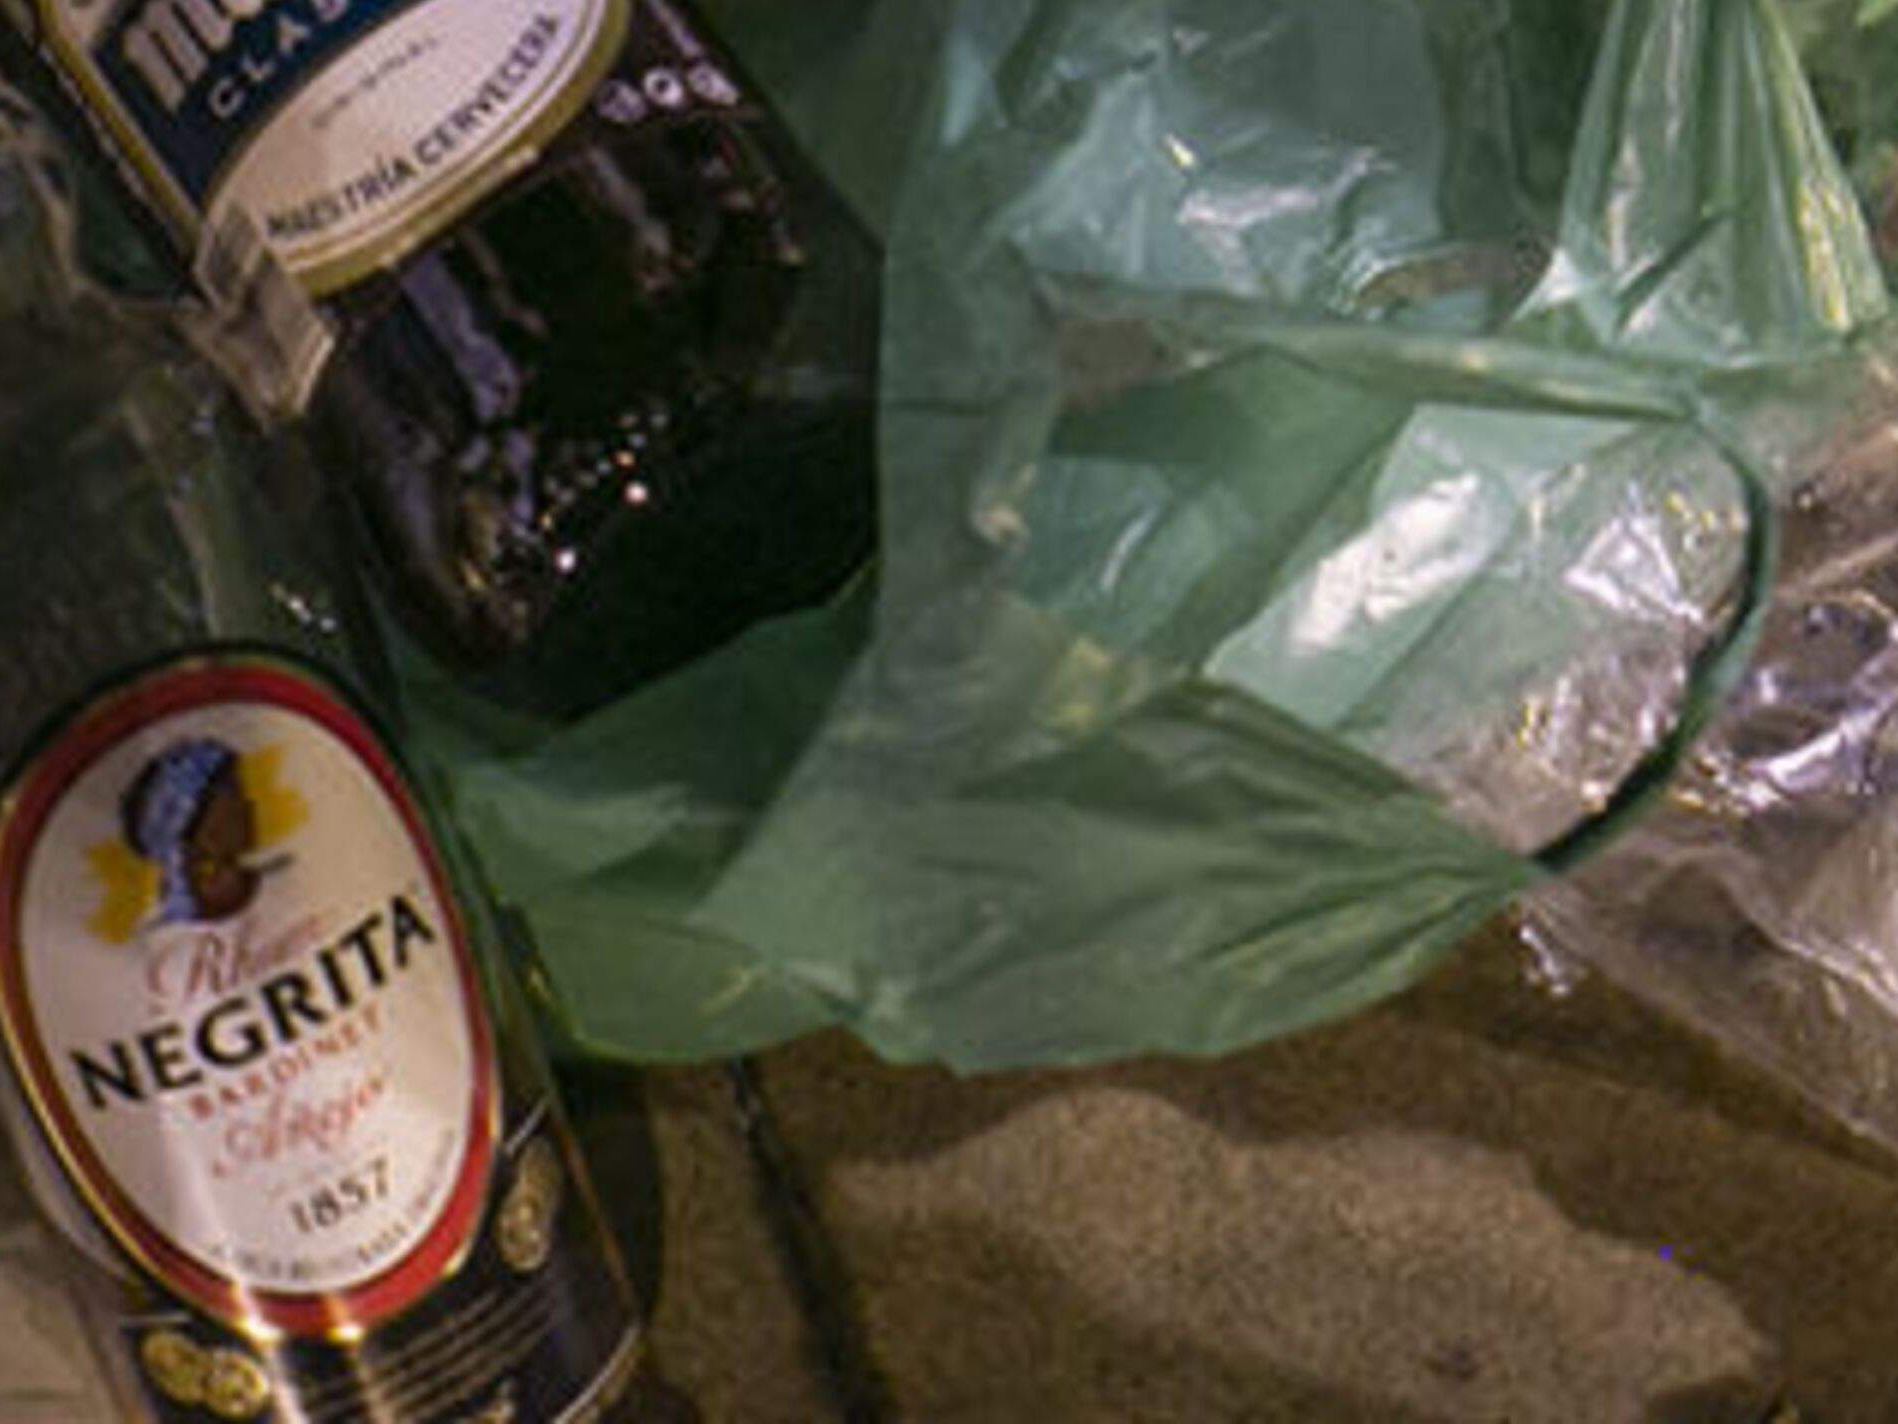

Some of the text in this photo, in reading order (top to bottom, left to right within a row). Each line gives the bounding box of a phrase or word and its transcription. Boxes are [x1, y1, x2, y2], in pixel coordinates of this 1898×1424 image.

[68, 894, 437, 1110] NEGRITA
[188, 1000, 382, 1120] BARDINET
[290, 1153, 391, 1233] 1857
